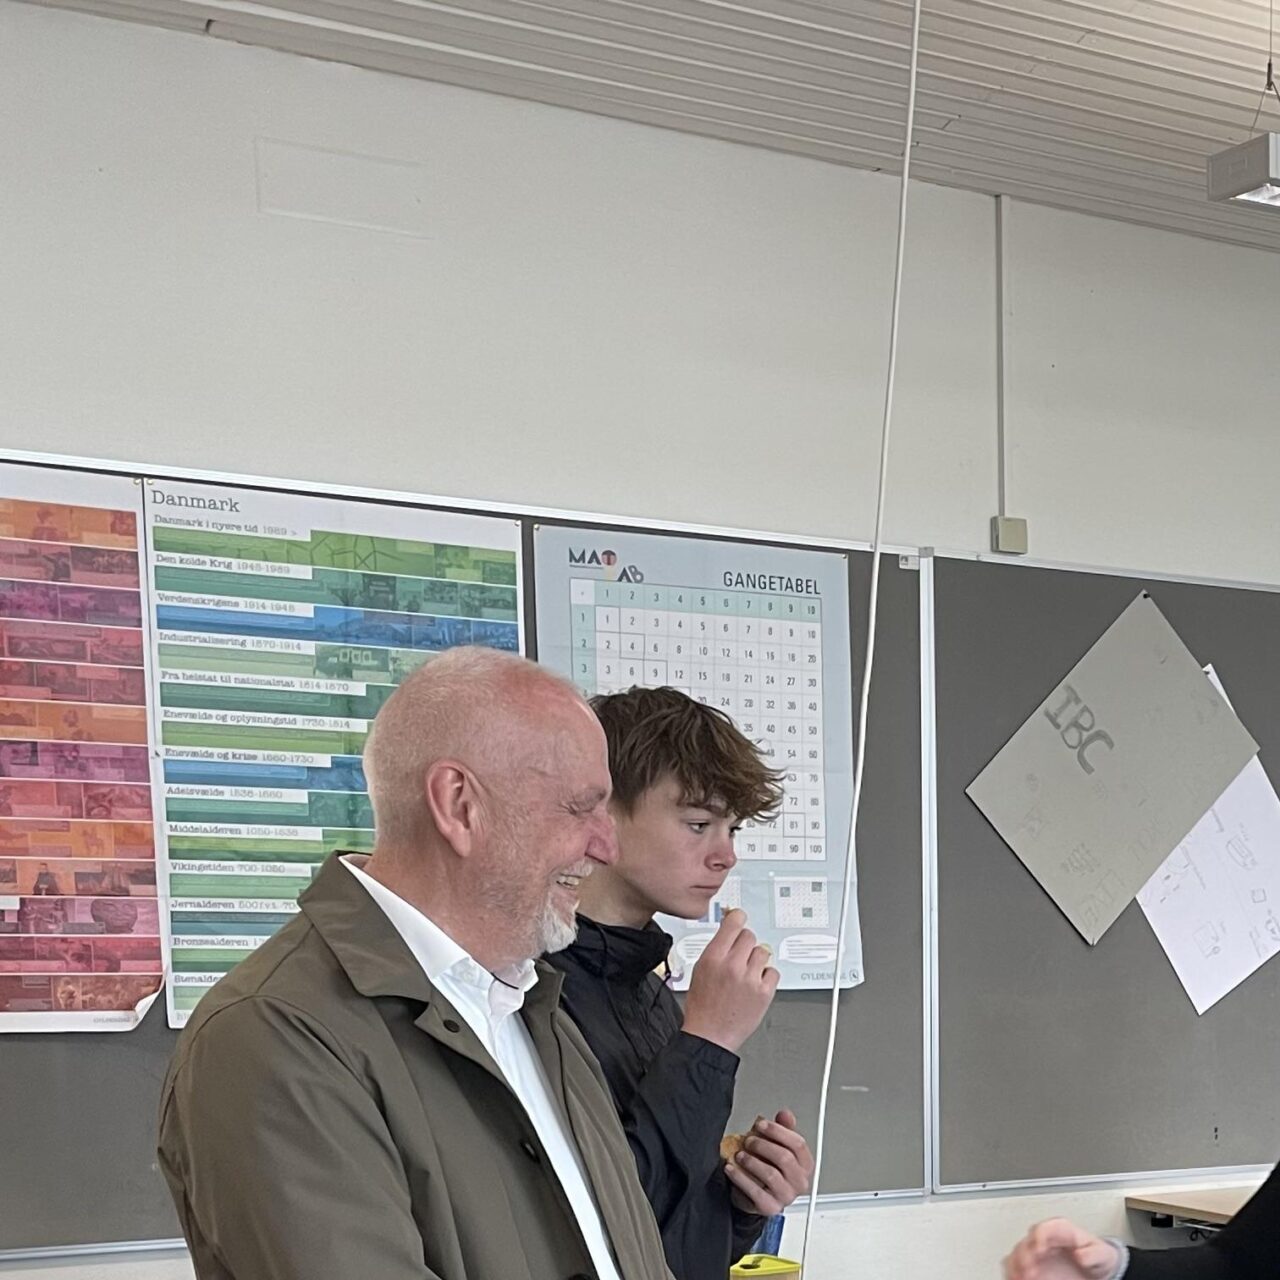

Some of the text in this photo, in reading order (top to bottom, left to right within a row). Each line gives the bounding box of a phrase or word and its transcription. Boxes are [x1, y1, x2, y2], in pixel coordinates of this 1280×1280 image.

[151, 490, 240, 513] Danmark
[154, 514, 203, 528] Danmark
[211, 521, 241, 532] nyere
[244, 523, 258, 533] tid
[262, 524, 287, 536] 1989
[156, 554, 177, 563] Den
[179, 555, 207, 566] kolde
[209, 559, 232, 570] Krig
[723, 570, 821, 595] GANGETABEL
[629, 590, 635, 600] 2
[654, 593, 659, 602] 3
[678, 594, 683, 603] 4
[700, 596, 705, 606] 5
[746, 600, 751, 609] 7
[630, 616, 635, 626] 2
[654, 618, 659, 628] 3
[678, 620, 682, 629] 4
[700, 621, 705, 631] 5
[723, 624, 728, 632] 6
[746, 625, 751, 634] 7
[159, 632, 247, 648] Industrialisering
[581, 638, 587, 648] 2
[606, 640, 611, 649] 2
[630, 642, 635, 650] 4
[699, 647, 708, 656] 10
[722, 648, 731, 658] 12
[744, 650, 753, 658] 14
[161, 670, 180, 680] Fra
[220, 673, 232, 683] til
[234, 675, 295, 688] nationalstat
[582, 664, 587, 673] 3
[606, 665, 611, 674] 3
[675, 670, 684, 679] 12
[698, 672, 707, 681] 15
[744, 674, 753, 683] 21
[766, 676, 775, 685] 24
[787, 677, 796, 686] 27
[720, 697, 731, 706] 24
[766, 700, 775, 709] 32
[163, 709, 213, 720] Enevælde
[215, 713, 227, 723] og
[230, 713, 297, 726] oplysningstid
[743, 723, 818, 735] 35 40 45 50
[1043, 684, 1115, 775] IBC
[165, 748, 215, 759] Enevælde
[217, 752, 229, 761] og
[231, 751, 258, 761] krise
[787, 749, 797, 758] 54
[789, 797, 798, 806] 72
[169, 825, 242, 835] Middelalderen
[747, 843, 756, 852] 70
[789, 844, 799, 853] 90
[809, 844, 822, 853] 100
[170, 862, 235, 873] Vikingetiden
[171, 900, 235, 909] Jernalderen
